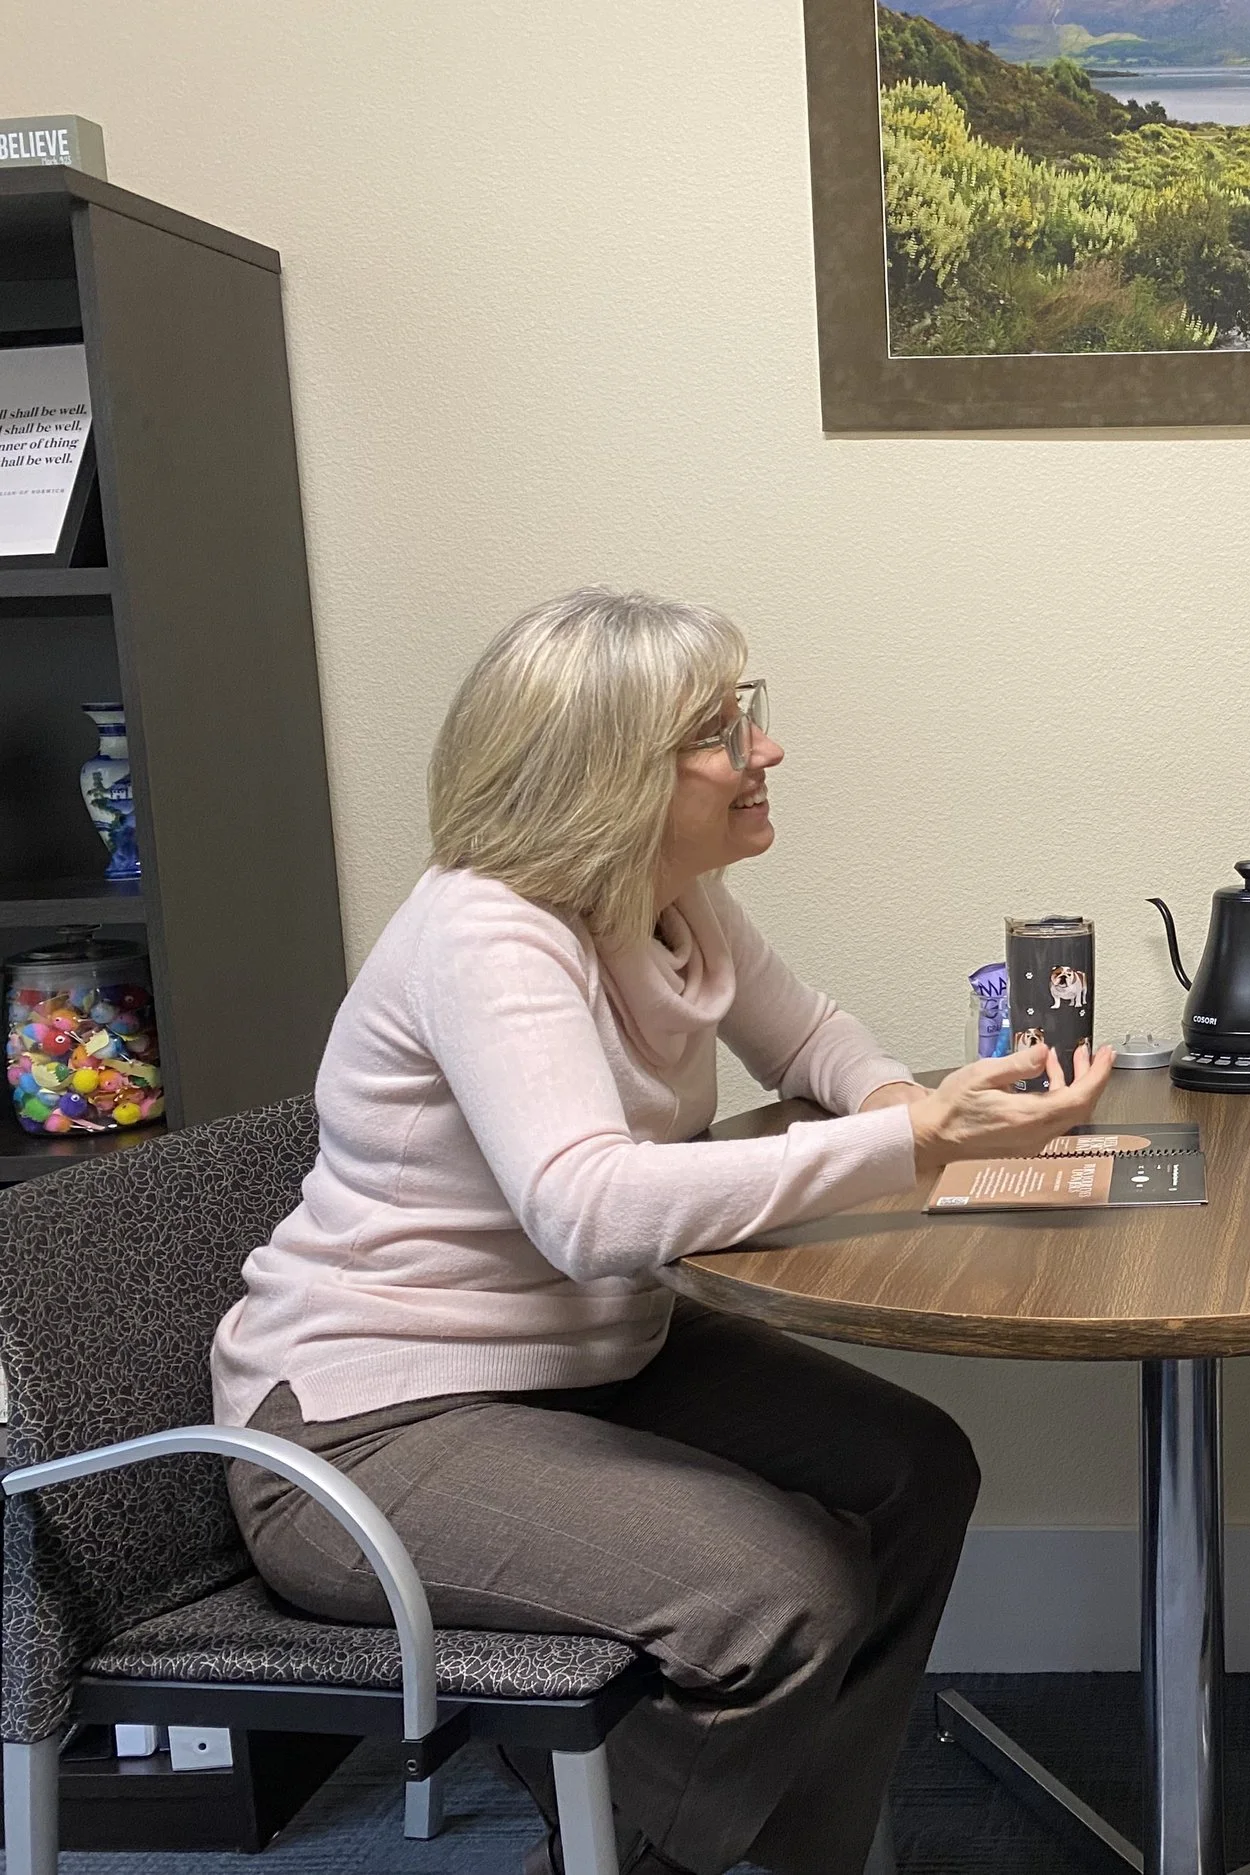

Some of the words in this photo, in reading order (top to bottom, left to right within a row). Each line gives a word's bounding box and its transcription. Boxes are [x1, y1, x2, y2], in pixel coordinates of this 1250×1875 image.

[0, 129, 70, 160] BELIEVE
[0, 409, 8, 420] ll
[9, 406, 40, 420] shall
[41, 406, 57, 417] be
[60, 403, 87, 416] well.
[4, 422, 34, 436] shall
[36, 422, 52, 433] be
[55, 420, 82, 432] well.
[0, 442, 28, 452] nner
[29, 438, 45, 450] of
[45, 437, 80, 450] thing
[0, 455, 25, 468] hall
[26, 454, 42, 466] be
[45, 453, 73, 465] well.
[1193, 1015, 1218, 1026] COSORI
